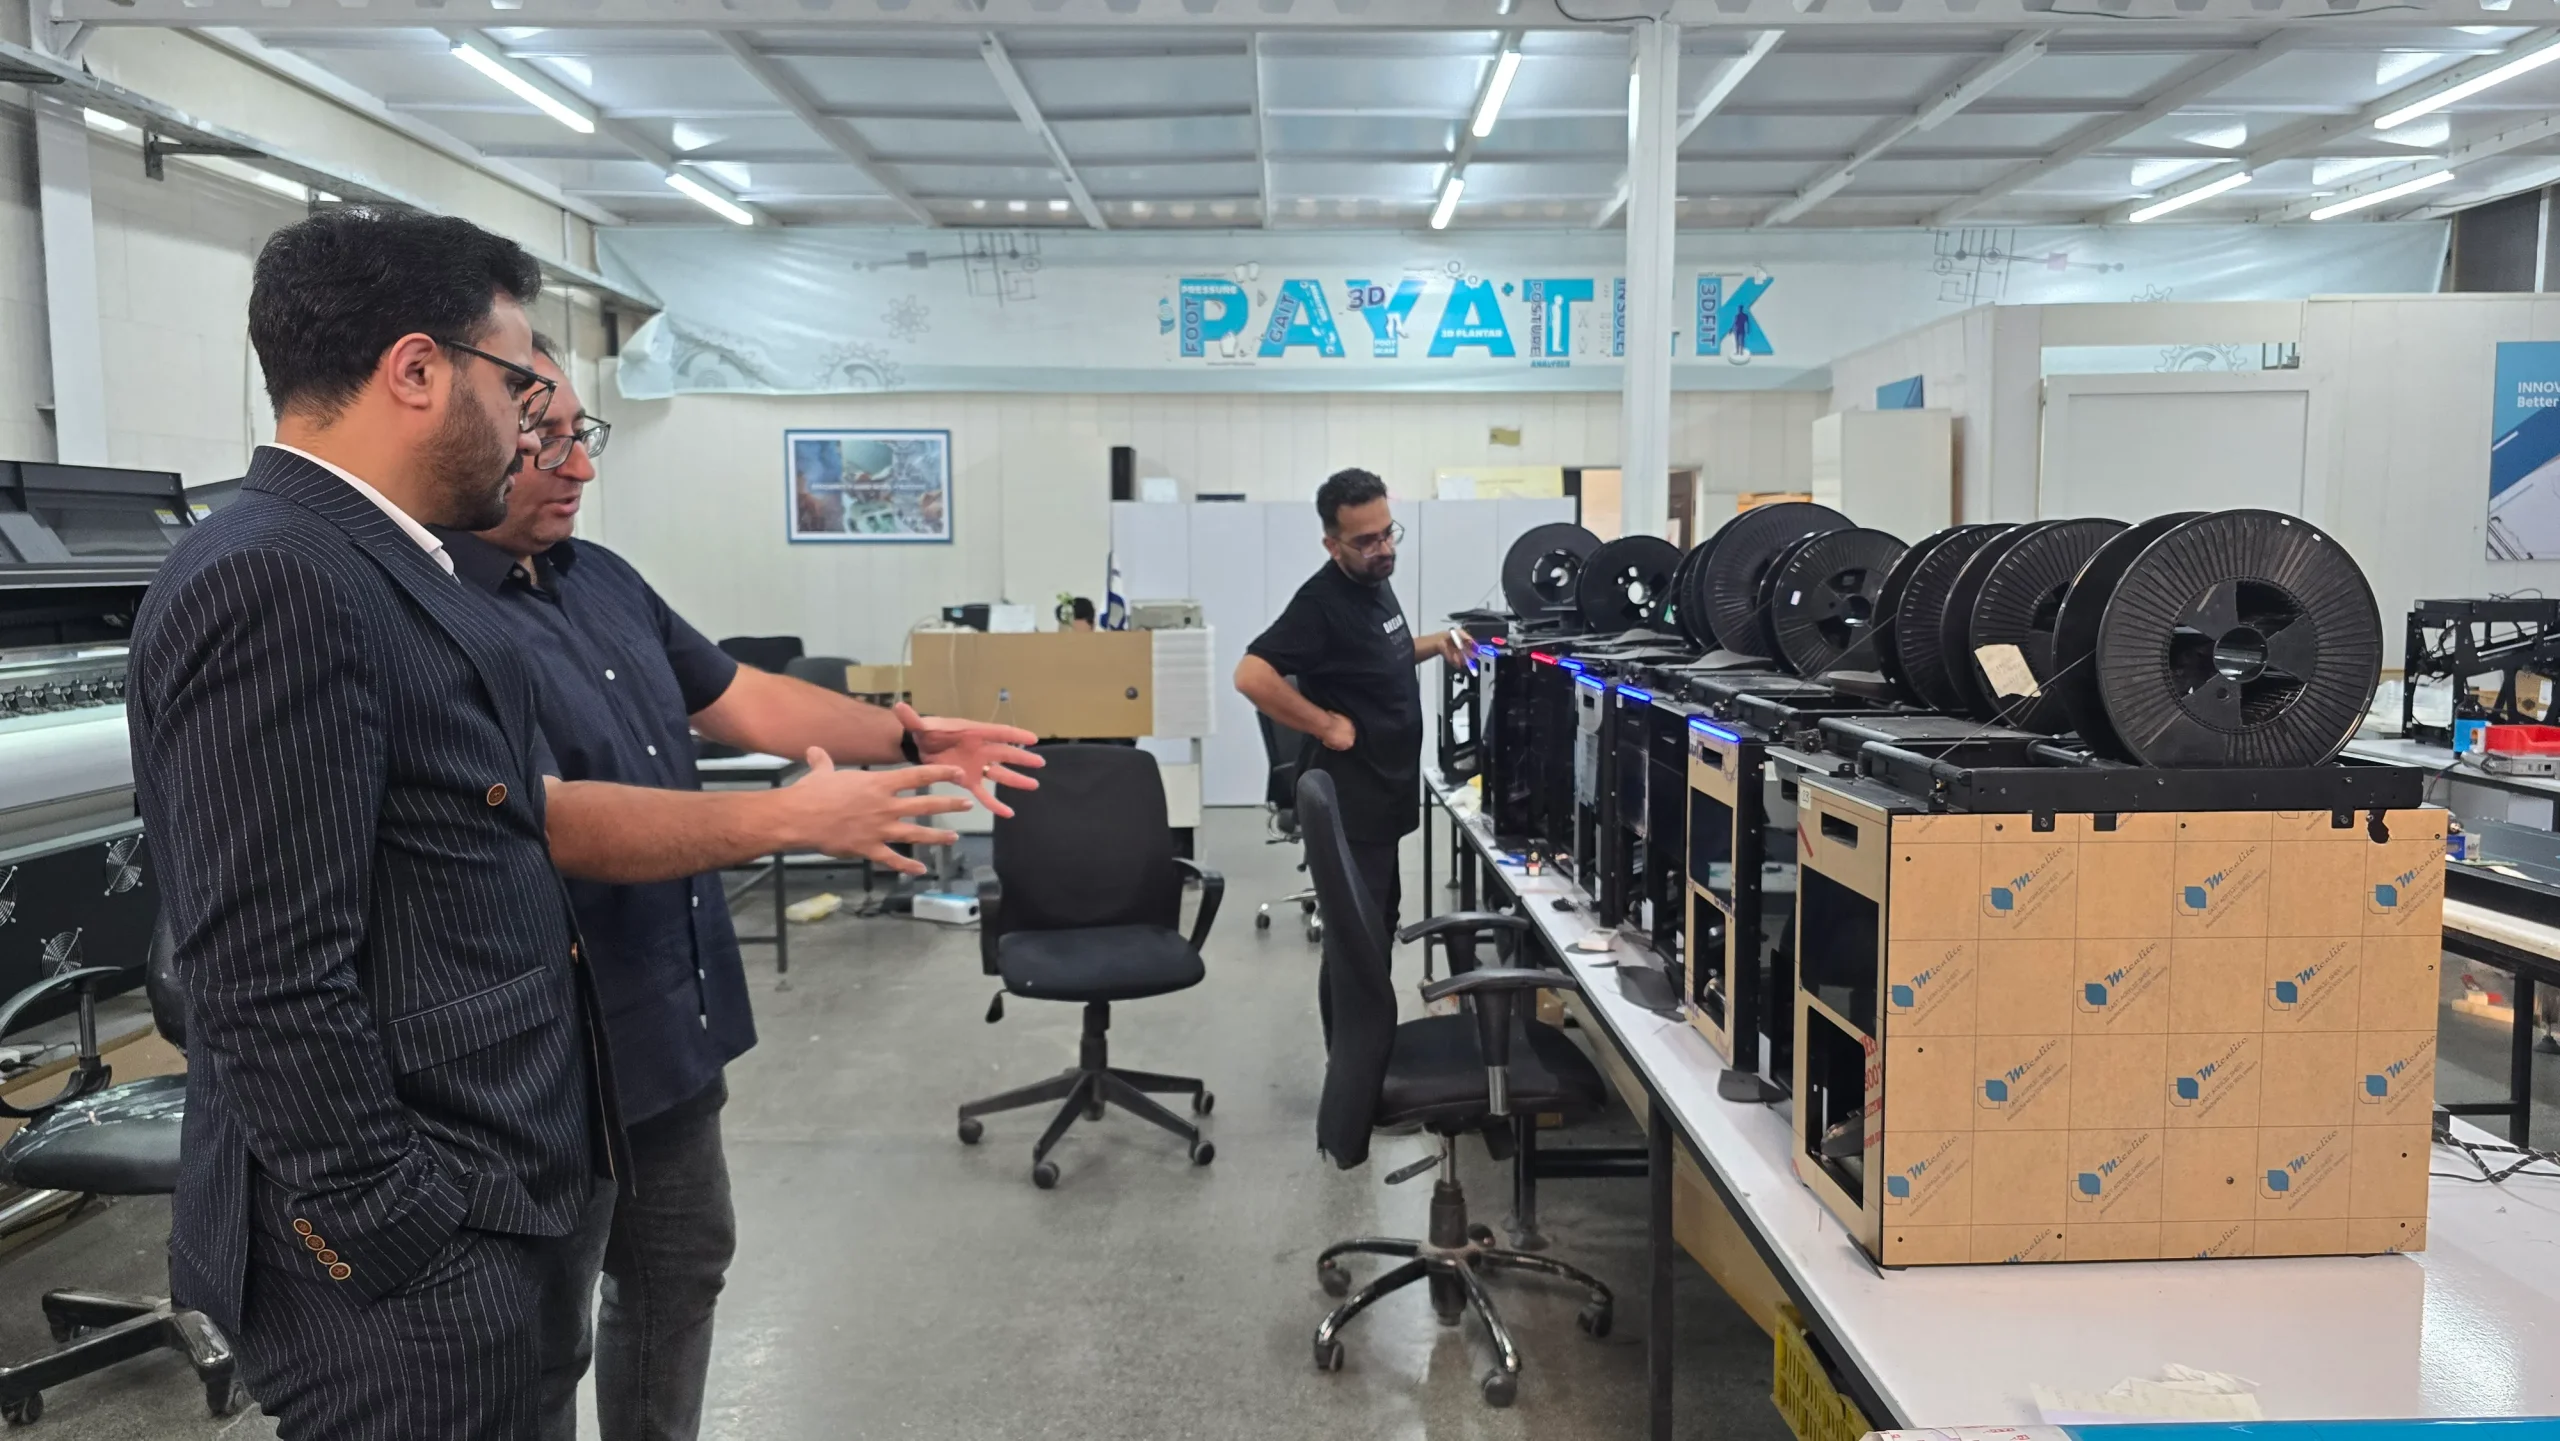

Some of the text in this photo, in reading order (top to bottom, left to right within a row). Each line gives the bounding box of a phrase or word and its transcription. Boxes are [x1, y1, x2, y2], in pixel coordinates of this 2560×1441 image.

[1181, 285, 1237, 294] PRESSURE
[1347, 286, 1386, 311] 3D
[1179, 277, 1774, 357] PAYATK
[1184, 297, 1199, 353] FOOT
[1269, 293, 1295, 343] GAIT
[1530, 281, 1543, 357] POSTURE
[2517, 396, 2560, 408] Better
[2011, 847, 2064, 892] Micalite
[2204, 845, 2257, 890] Micalite
[1911, 944, 1964, 989] Micalite
[2104, 943, 2157, 987] Micalite
[2295, 941, 2348, 985] Micalite
[2005, 1039, 2058, 1084] Micalite
[2196, 1037, 2249, 1081] Micalite
[1906, 1136, 1960, 1180] Micalite
[2097, 1133, 2150, 1177] Micalite
[2286, 1130, 2339, 1174] Micalite
